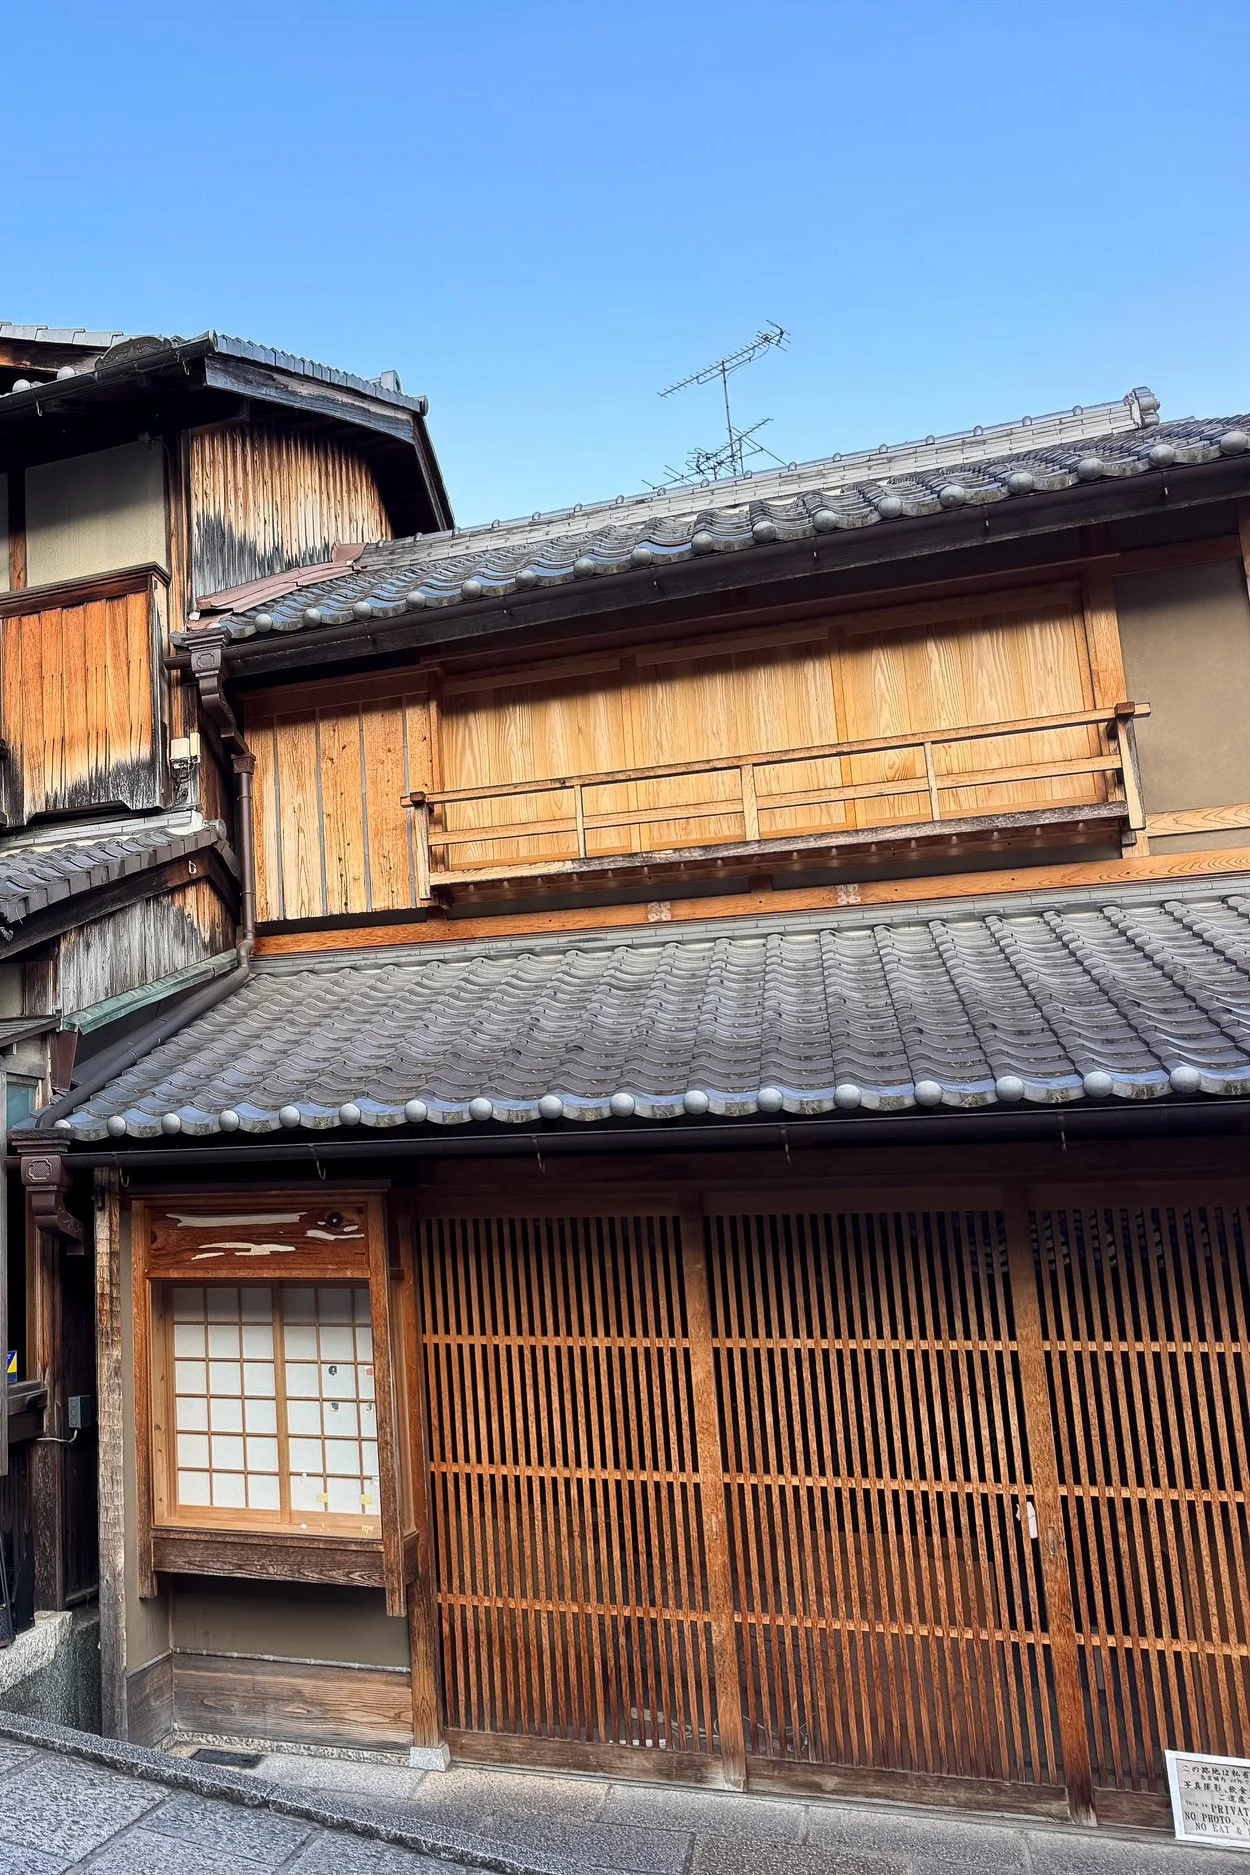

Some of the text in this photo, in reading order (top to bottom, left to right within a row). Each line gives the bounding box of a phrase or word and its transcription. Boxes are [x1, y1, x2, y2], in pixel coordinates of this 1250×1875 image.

[1183, 1780, 1250, 1795] 写真撮影、飲食
[1218, 1793, 1250, 1805] ご遠慮
[1184, 1811, 1197, 1821] NO
[1195, 1821, 1207, 1831] NO
[1212, 1823, 1231, 1834] EAT
